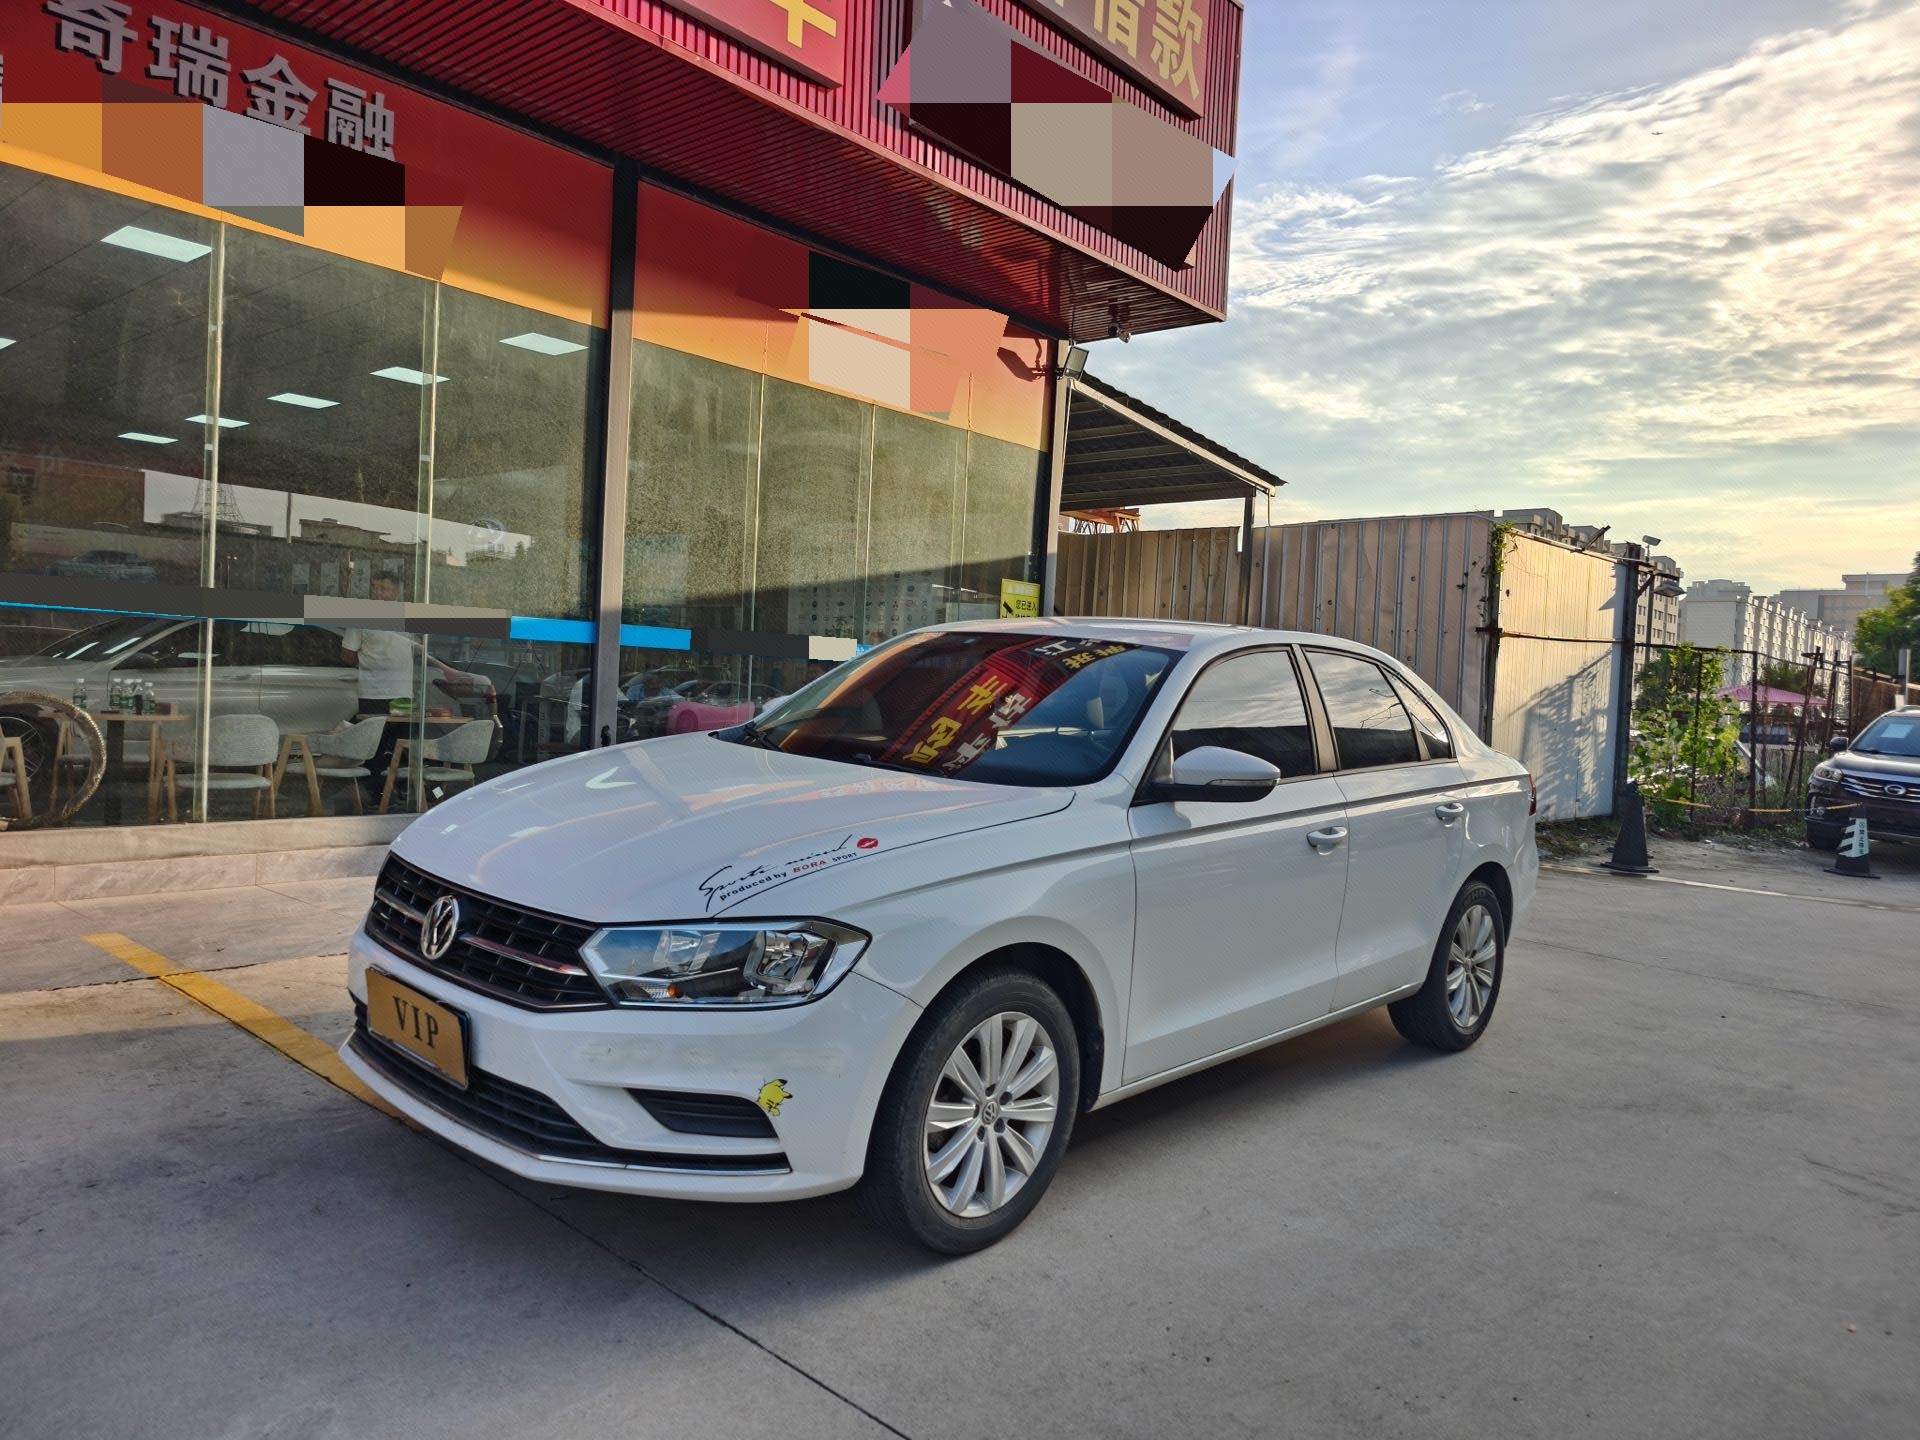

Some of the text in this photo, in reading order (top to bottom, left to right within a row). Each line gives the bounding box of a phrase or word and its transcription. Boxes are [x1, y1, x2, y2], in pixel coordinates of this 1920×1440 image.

[47, 0, 398, 162] 奇瑞金融
[719, 851, 858, 901] produced by BORA SPORT
[393, 996, 440, 1049] VIP
